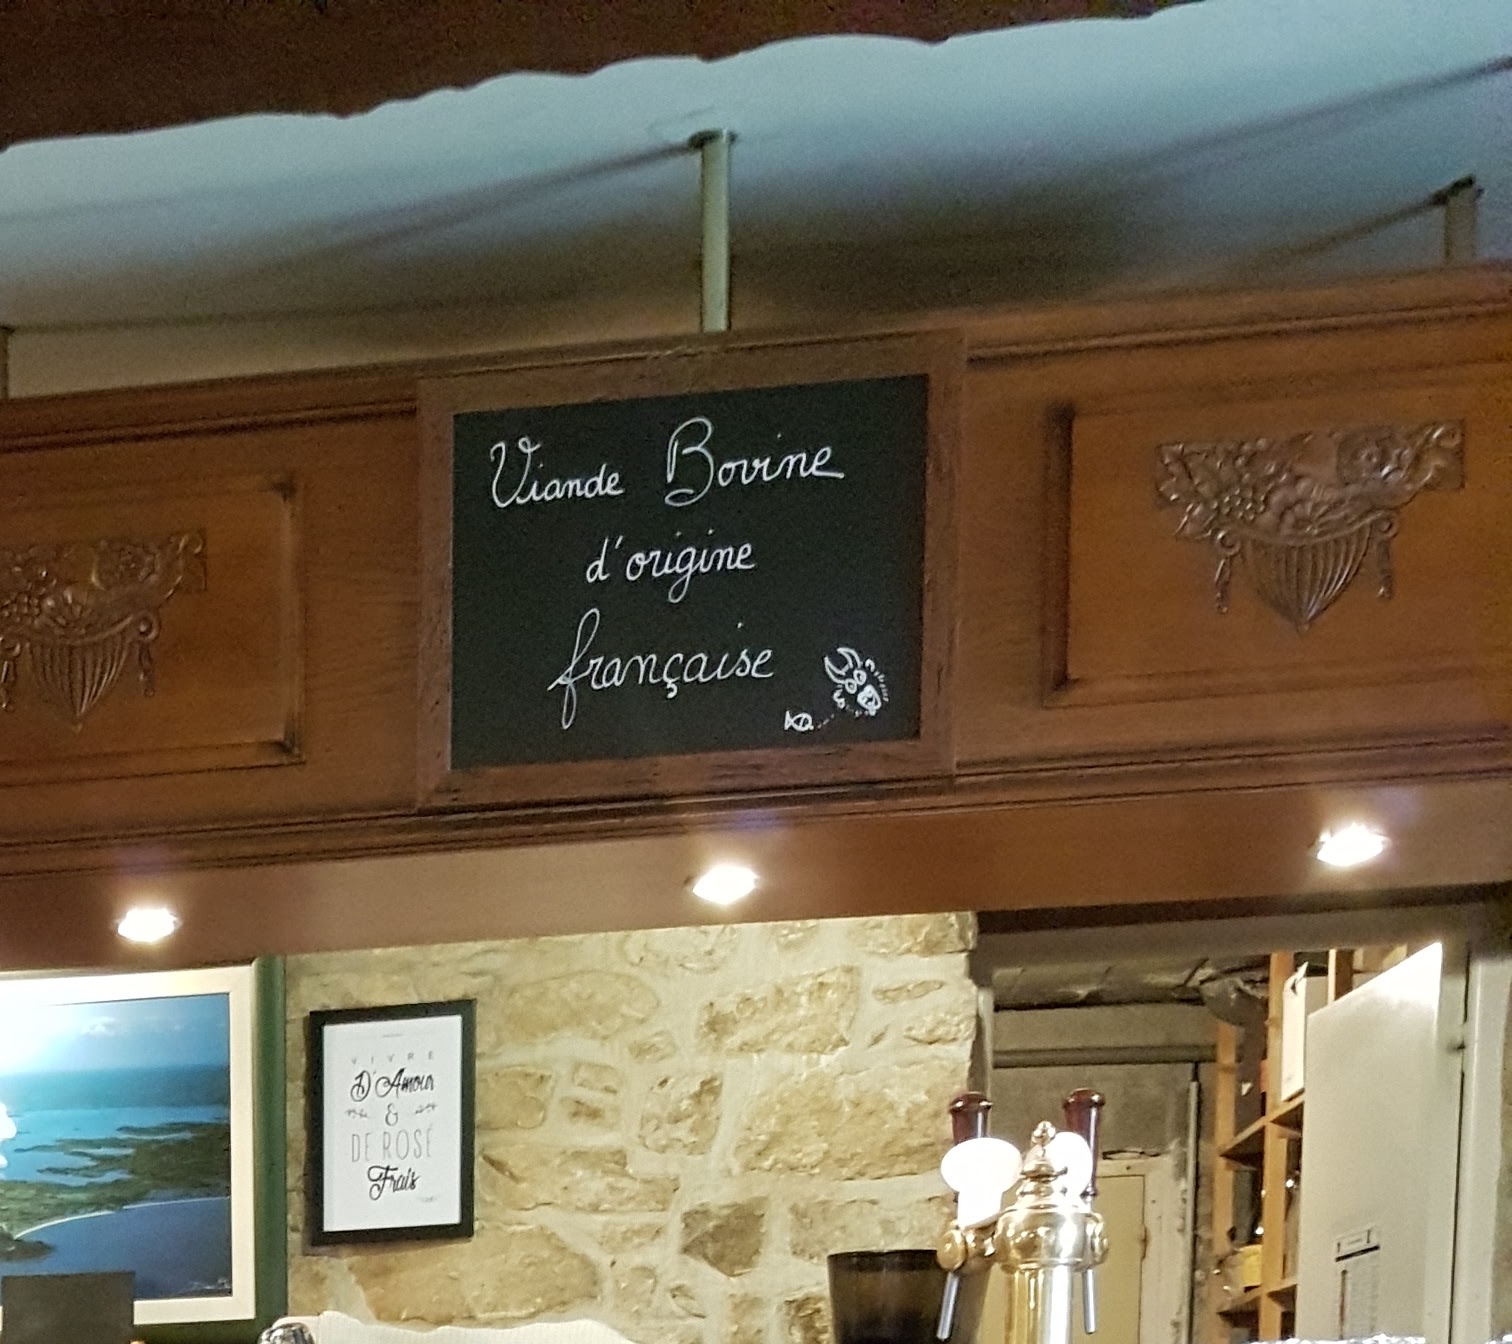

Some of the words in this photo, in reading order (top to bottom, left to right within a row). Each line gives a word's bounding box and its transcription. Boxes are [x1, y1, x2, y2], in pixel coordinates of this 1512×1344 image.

[490, 436, 625, 508] Viande
[665, 416, 846, 507] Bovine
[586, 529, 756, 603] d'origine
[548, 608, 775, 730] française
[385, 1103, 399, 1126] &
[367, 1165, 421, 1201] Frais
